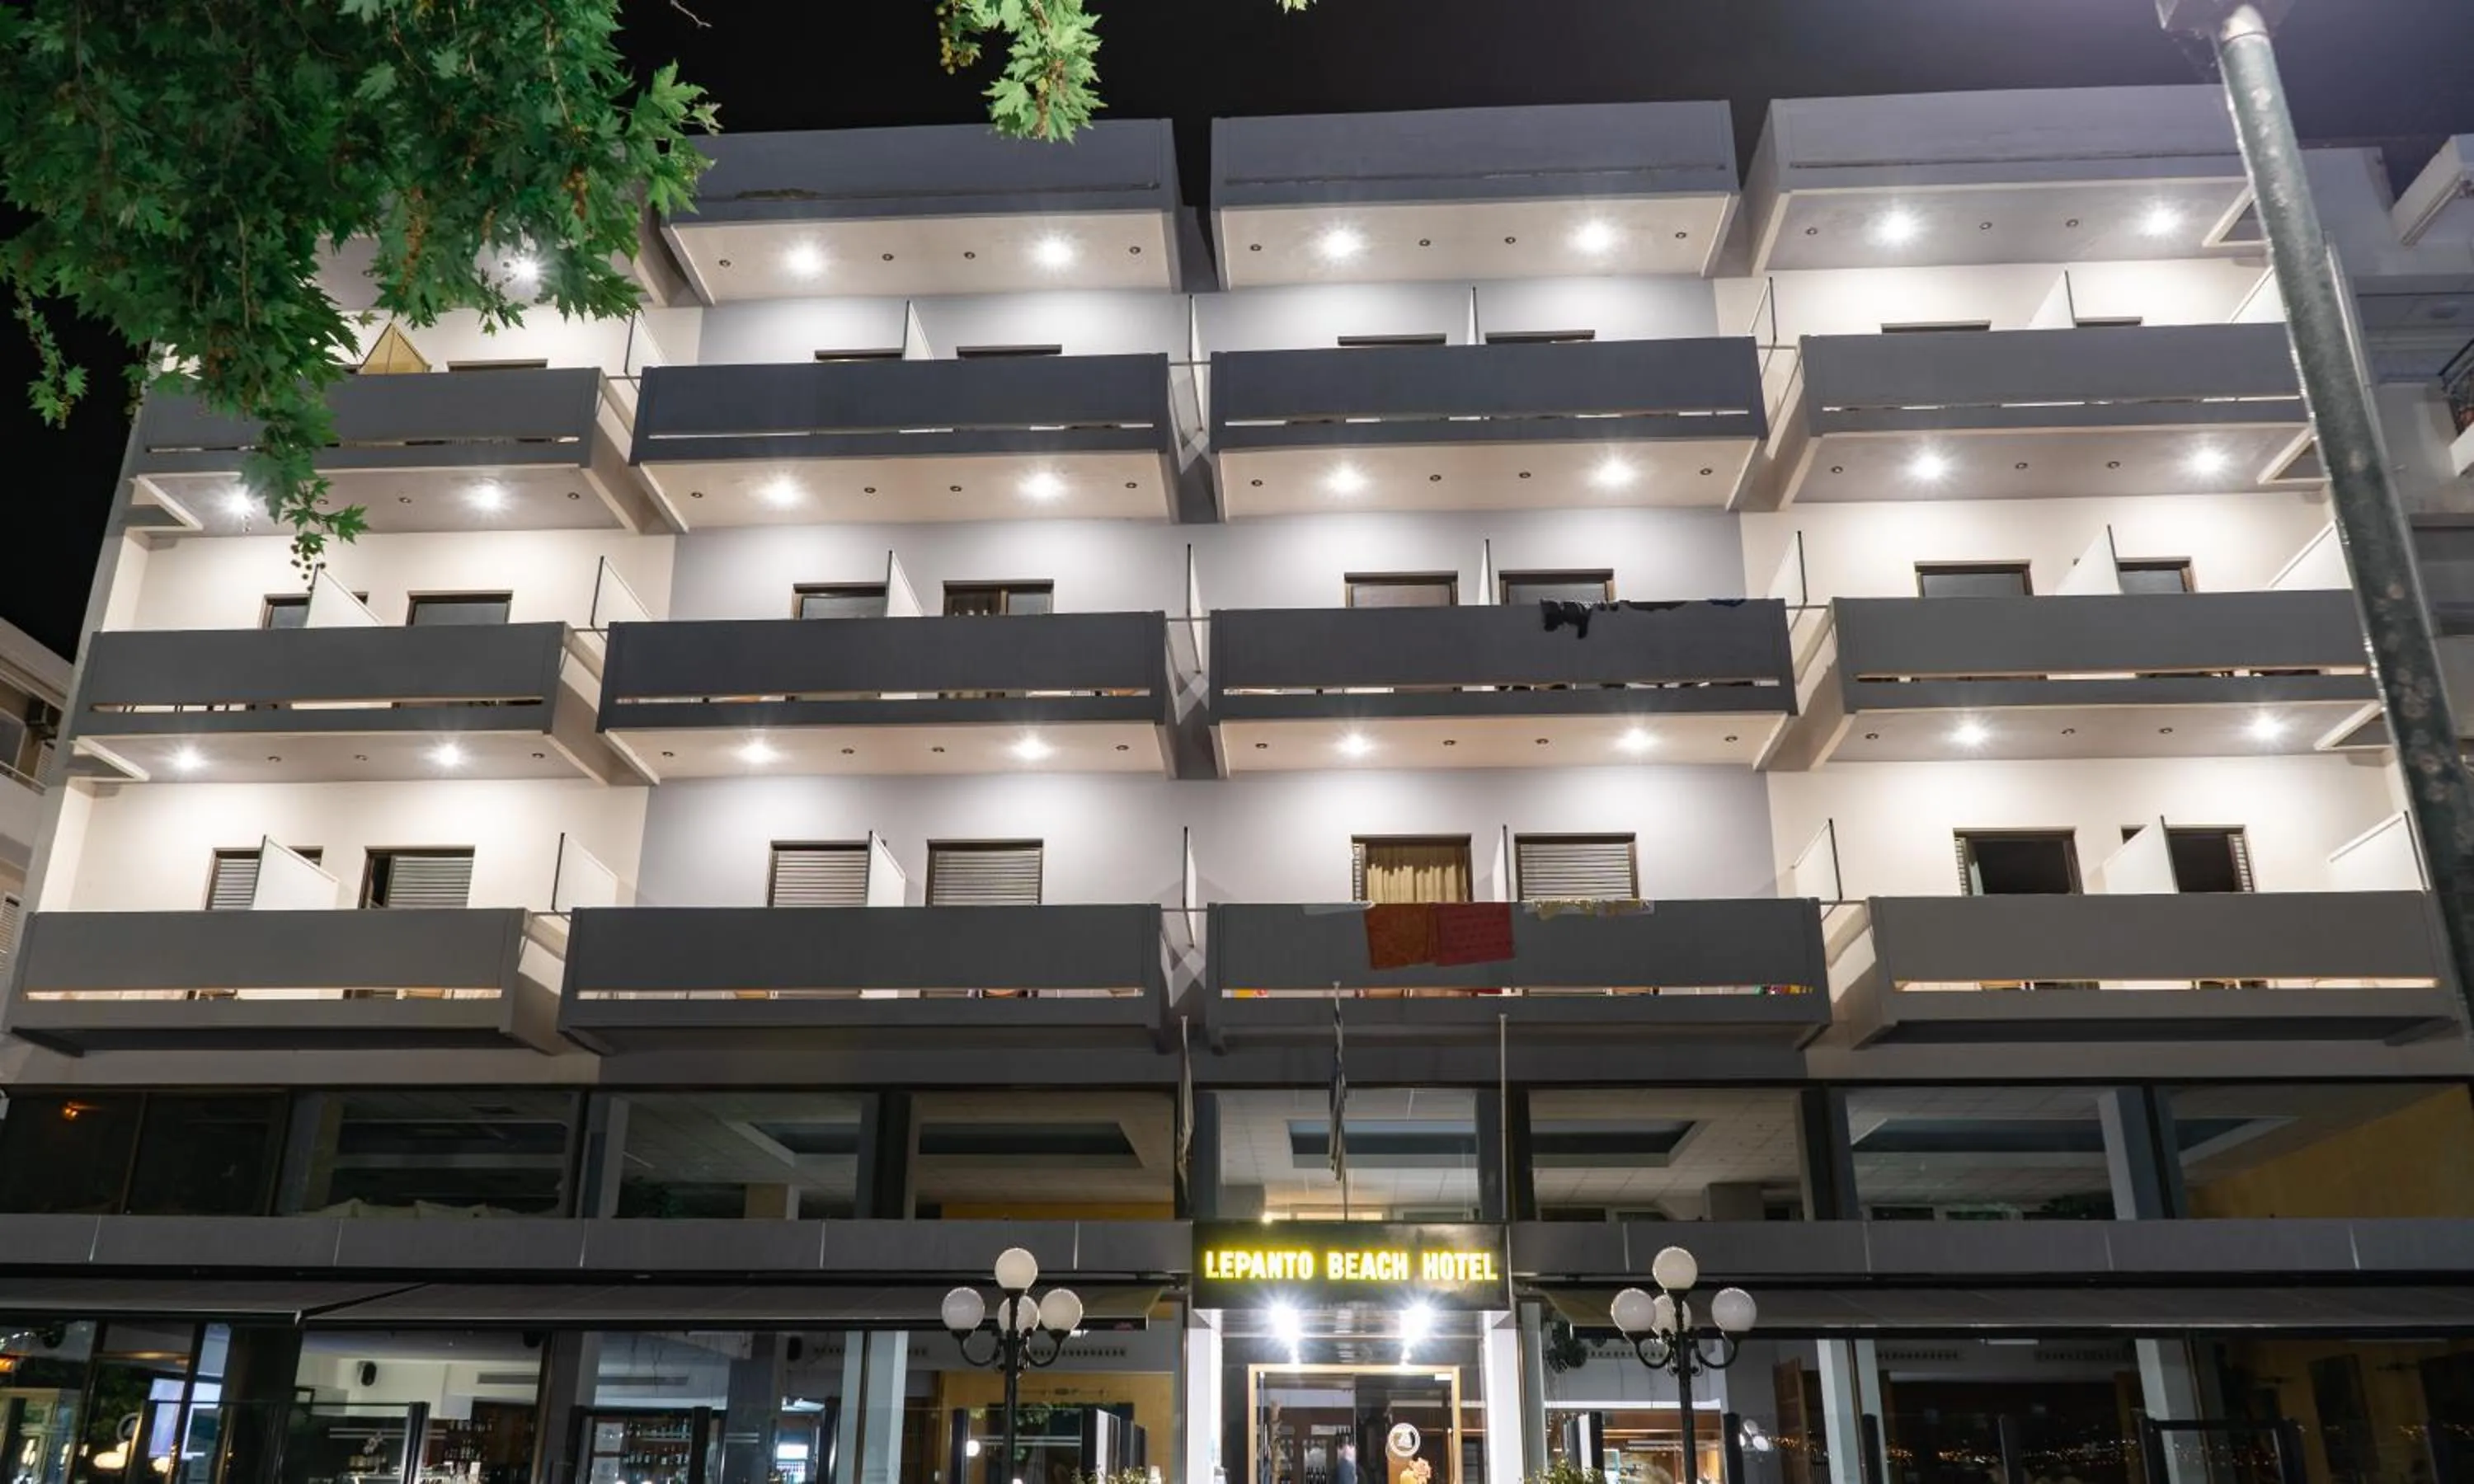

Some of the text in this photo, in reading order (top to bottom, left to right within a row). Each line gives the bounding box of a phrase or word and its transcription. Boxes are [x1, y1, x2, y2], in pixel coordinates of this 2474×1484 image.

[1204, 1250, 1498, 1280] LEPANTO BEACH HOTEL
